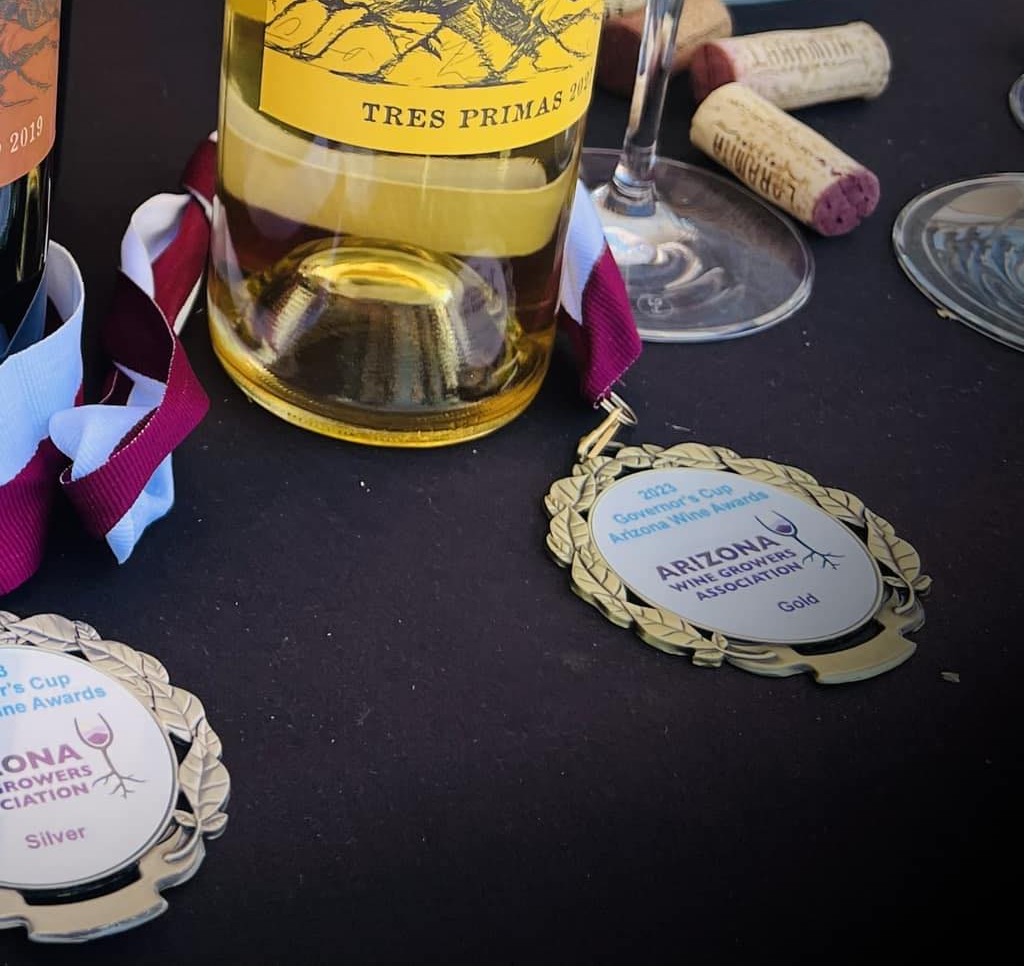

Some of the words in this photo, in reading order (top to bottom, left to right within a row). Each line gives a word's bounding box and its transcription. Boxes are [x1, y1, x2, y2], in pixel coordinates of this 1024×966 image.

[362, 101, 446, 130] TRES
[459, 90, 563, 130] PRIMAS
[10, 114, 46, 153] 2019
[611, 494, 701, 527] Governor's
[701, 483, 735, 505] Cup
[637, 481, 678, 502] 2023
[608, 519, 671, 546] Arizona
[673, 507, 712, 528] Wine
[714, 489, 771, 516] Awards
[655, 533, 782, 582] ARIZONA
[668, 571, 718, 595] WINE
[718, 547, 799, 580] GROWERS
[695, 561, 806, 603] ASSOCIATION
[777, 592, 821, 615] Gold
[28, 671, 72, 695] Cup
[31, 683, 108, 711] Awards
[24, 825, 88, 850] Silver
